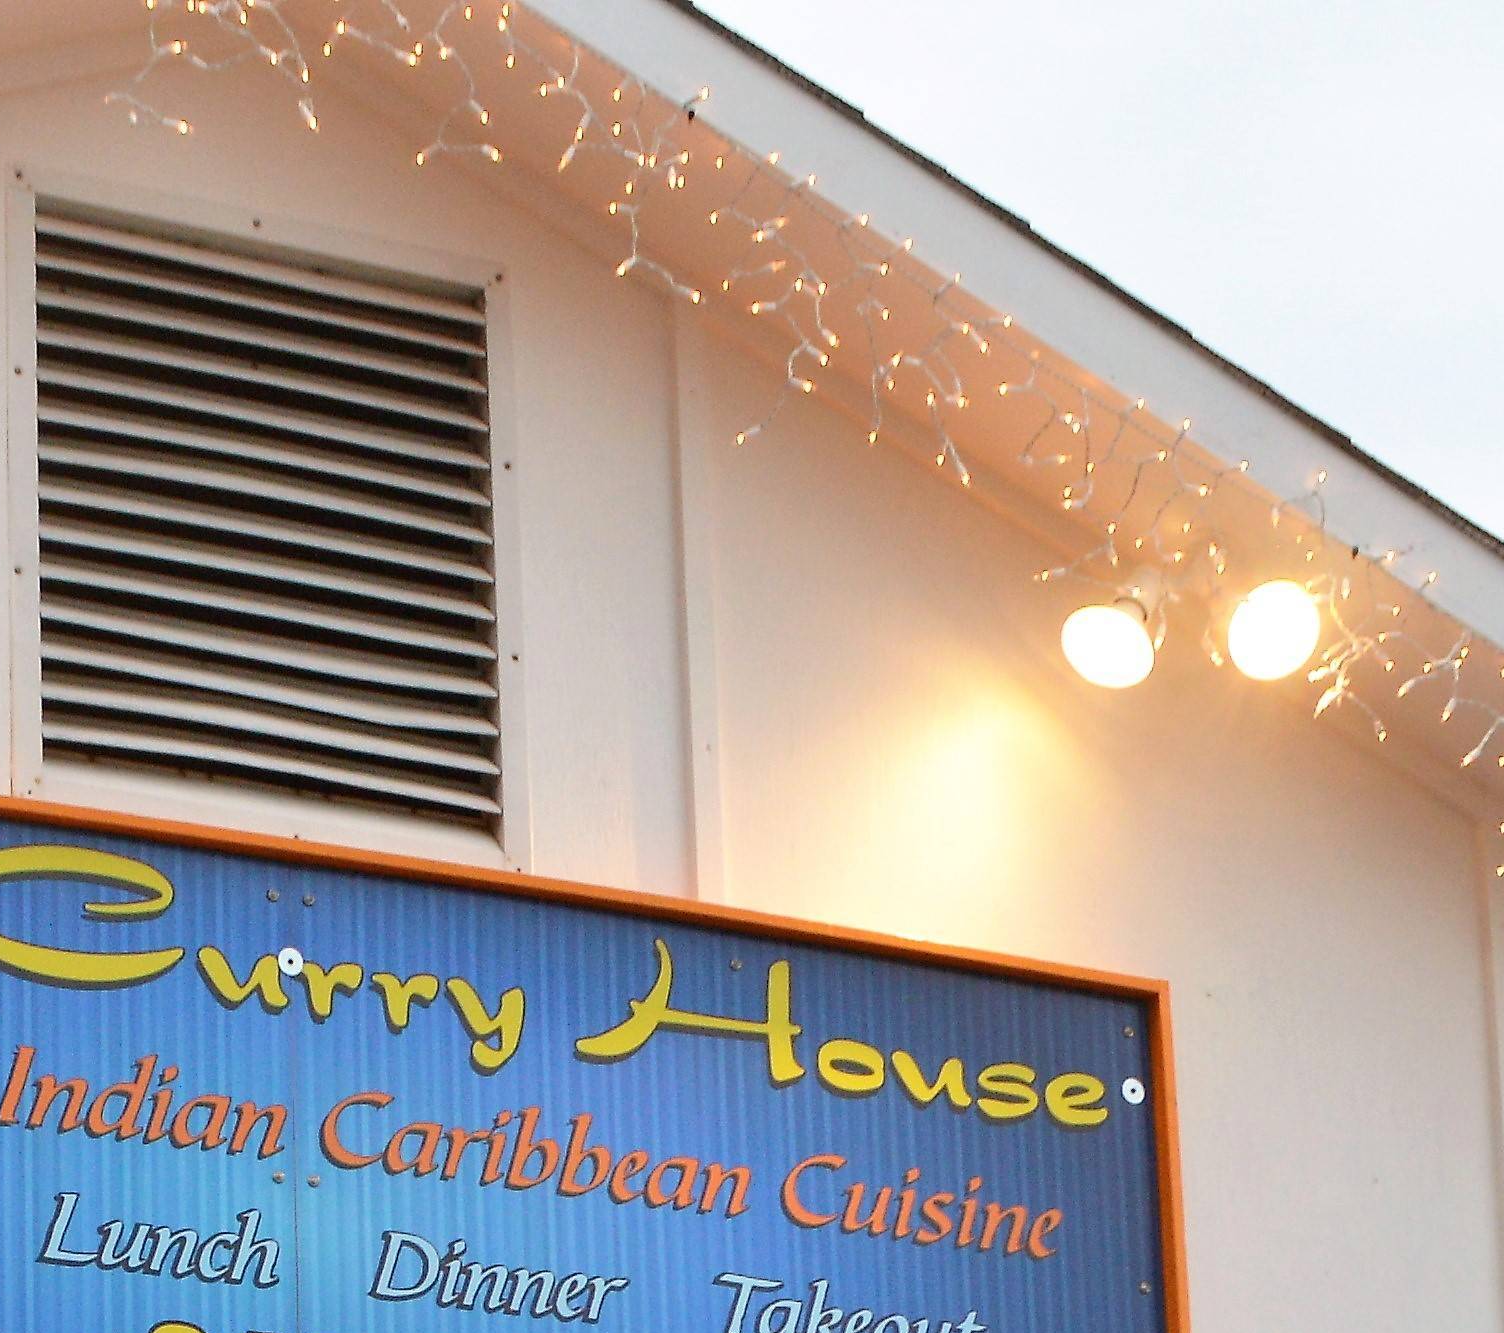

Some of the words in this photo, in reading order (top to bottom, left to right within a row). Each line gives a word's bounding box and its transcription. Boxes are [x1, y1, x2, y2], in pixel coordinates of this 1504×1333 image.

[574, 938, 1109, 1126] House
[36, 1192, 280, 1288] Lunch
[369, 1229, 629, 1324] Dinner
[318, 1091, 751, 1218] Caribbean
[781, 1154, 1063, 1259] Cuisine
